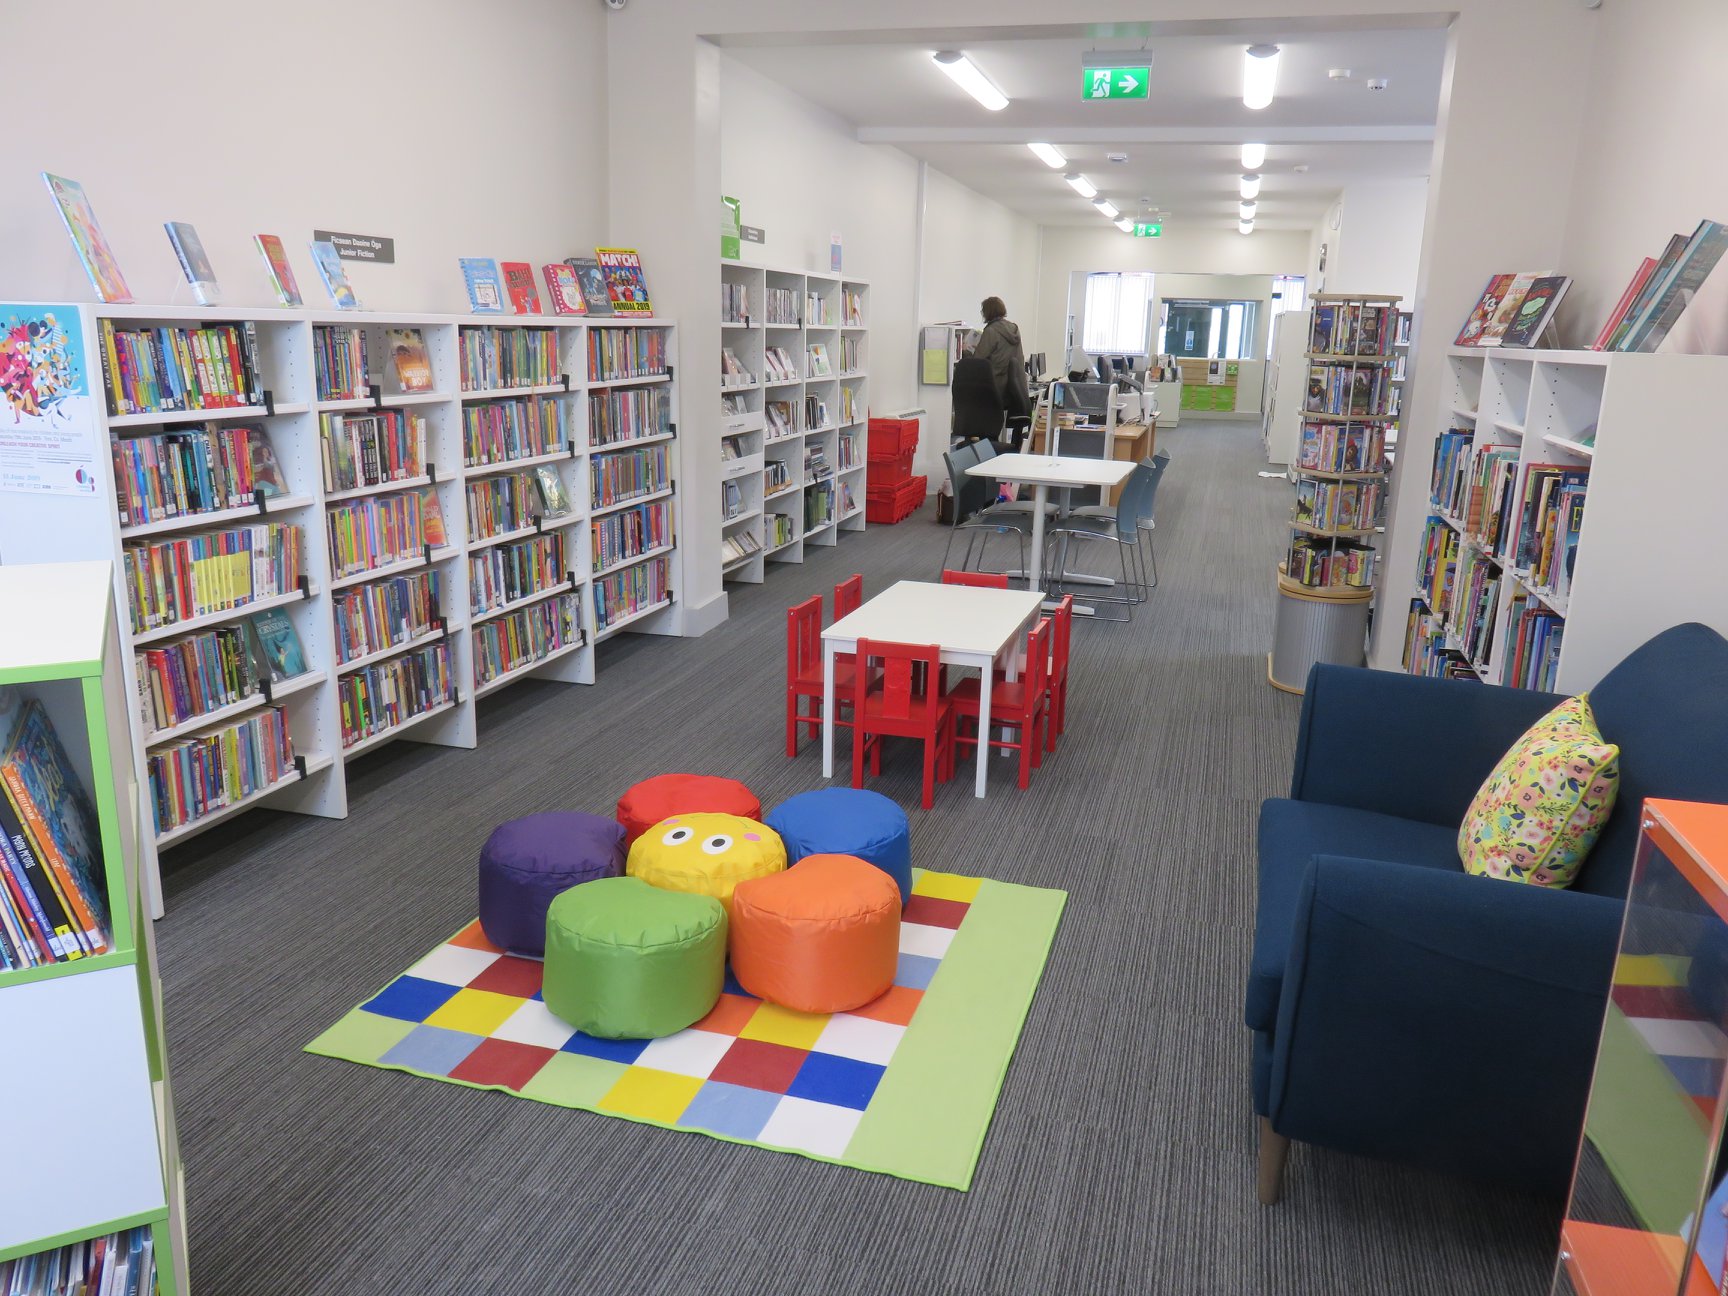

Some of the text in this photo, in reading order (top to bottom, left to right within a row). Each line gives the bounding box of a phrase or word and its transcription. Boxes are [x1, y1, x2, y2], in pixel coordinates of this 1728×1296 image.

[340, 247, 375, 259] Junior Fiction
[600, 253, 640, 267] MATCH!
[613, 302, 651, 311] ANNUAL 2019
